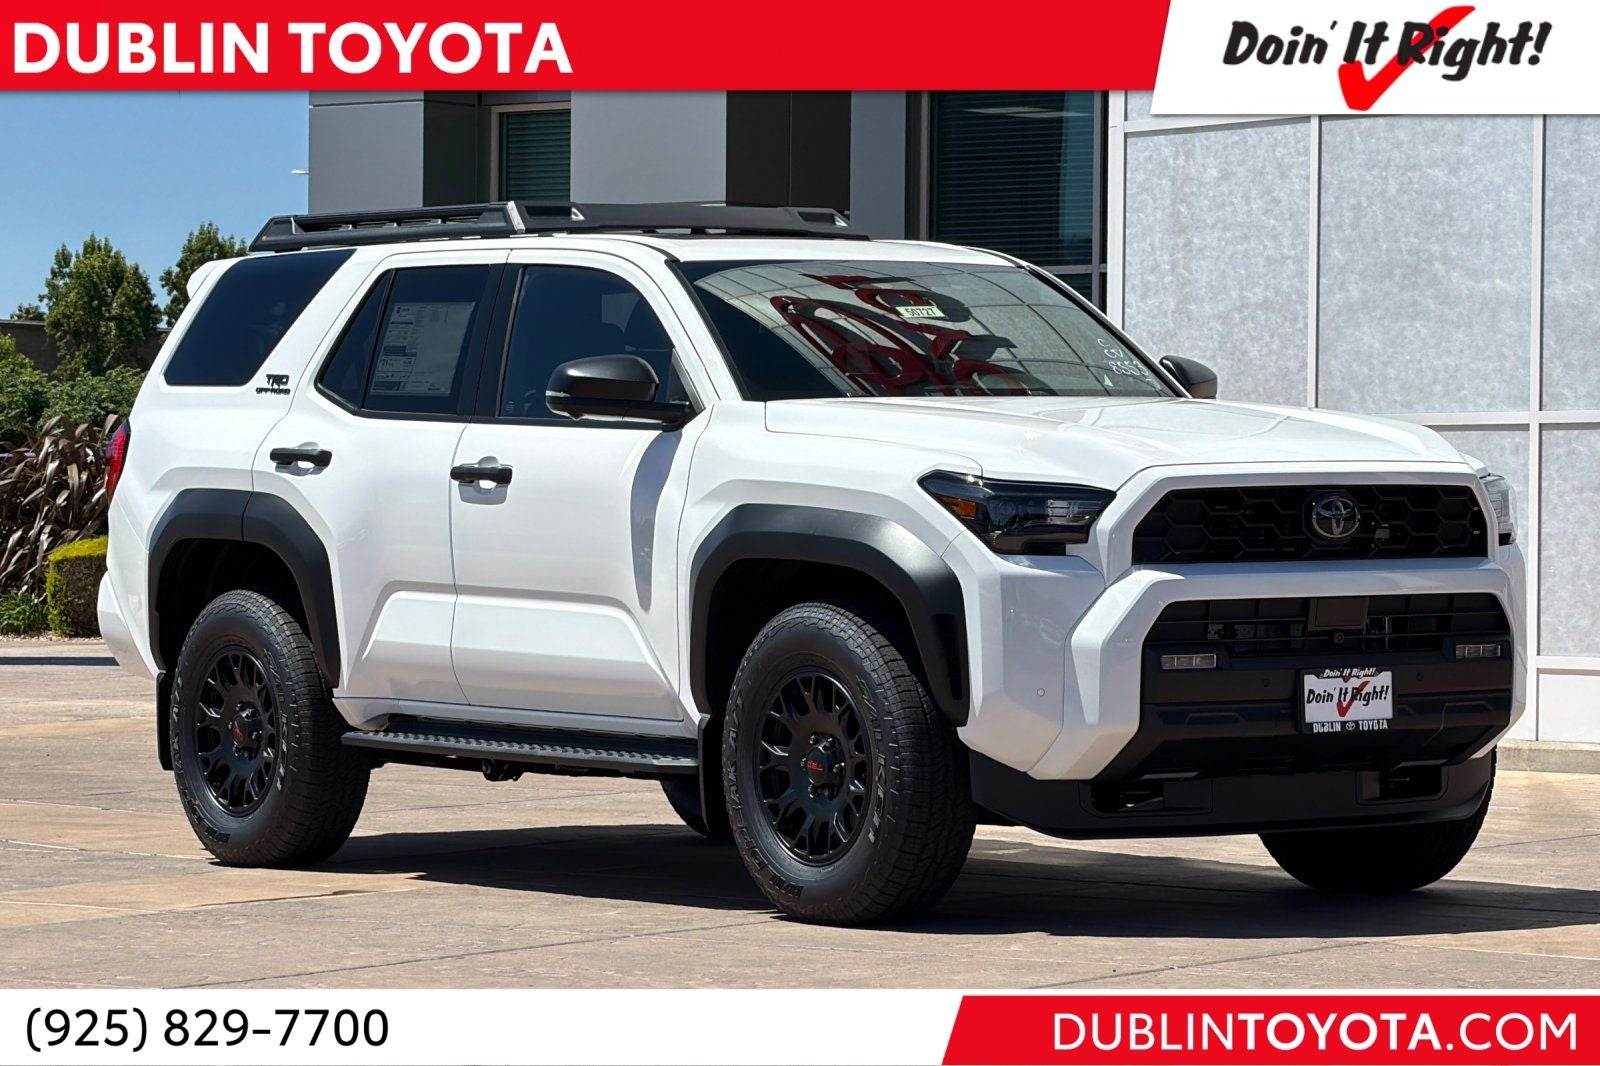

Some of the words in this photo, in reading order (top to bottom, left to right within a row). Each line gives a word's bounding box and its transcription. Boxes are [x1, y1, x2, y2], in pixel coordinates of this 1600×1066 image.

[1306, 687, 1336, 704] Doin'
[1338, 686, 1349, 702] It
[1351, 685, 1390, 707] Right!
[1313, 722, 1341, 733] DUBLIN
[1358, 719, 1389, 731] TOYOTA
